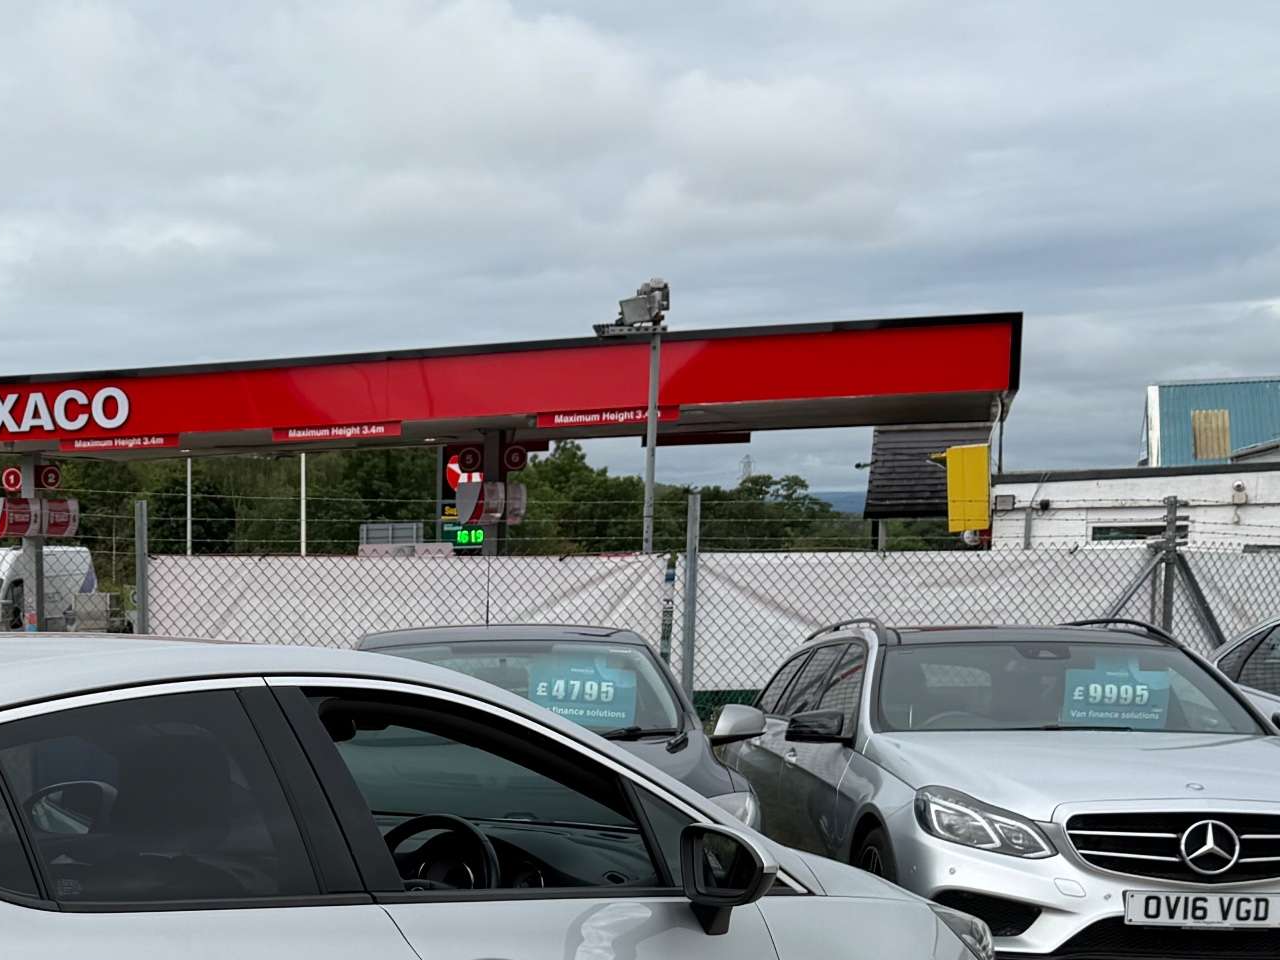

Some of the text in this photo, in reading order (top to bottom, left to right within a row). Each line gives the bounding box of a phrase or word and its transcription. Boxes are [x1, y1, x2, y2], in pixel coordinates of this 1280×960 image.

[554, 409, 661, 424] Maximum Height 3.
[288, 425, 385, 438] Maximum Height 3.4m
[74, 436, 164, 449] Maximum Height 3.4m
[512, 453, 519, 463] 6
[8, 474, 15, 484] 1
[47, 473, 56, 483] 2
[552, 706, 626, 718] finance solutions
[1070, 710, 1086, 718] Van
[1088, 710, 1119, 718] finance
[1121, 710, 1159, 719] solutions
[1144, 895, 1269, 921] OV16 VGD
